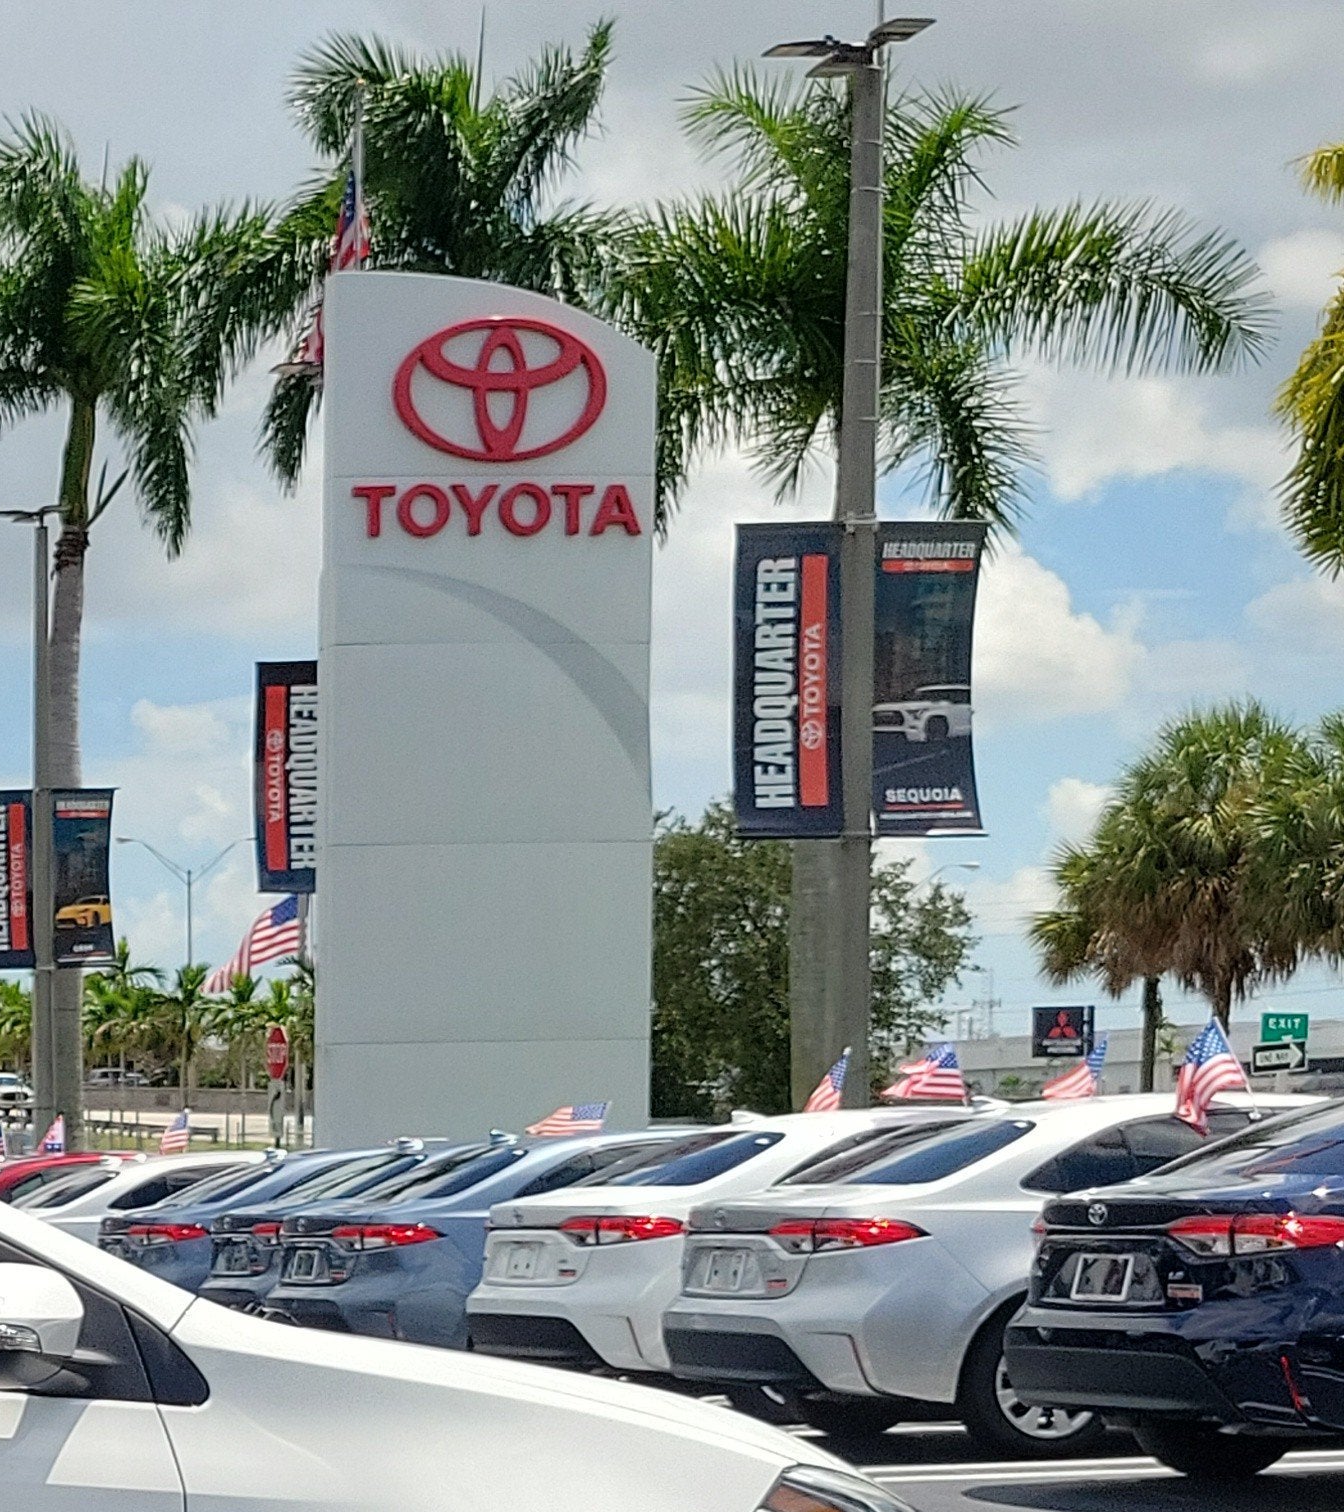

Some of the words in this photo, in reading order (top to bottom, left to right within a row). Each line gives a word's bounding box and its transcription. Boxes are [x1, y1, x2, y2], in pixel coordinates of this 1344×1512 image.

[352, 483, 642, 538] TOYOTA
[882, 541, 975, 560] HEADQUARTER
[753, 557, 799, 808] HEADQUARTER
[801, 623, 823, 716] TOYOTA
[268, 753, 283, 822] TOYOTA
[285, 685, 317, 869] HEADQUARTER
[885, 787, 963, 803] SEQUOIA
[11, 843, 24, 903] TOYOTA
[1268, 1017, 1301, 1030] EXIT
